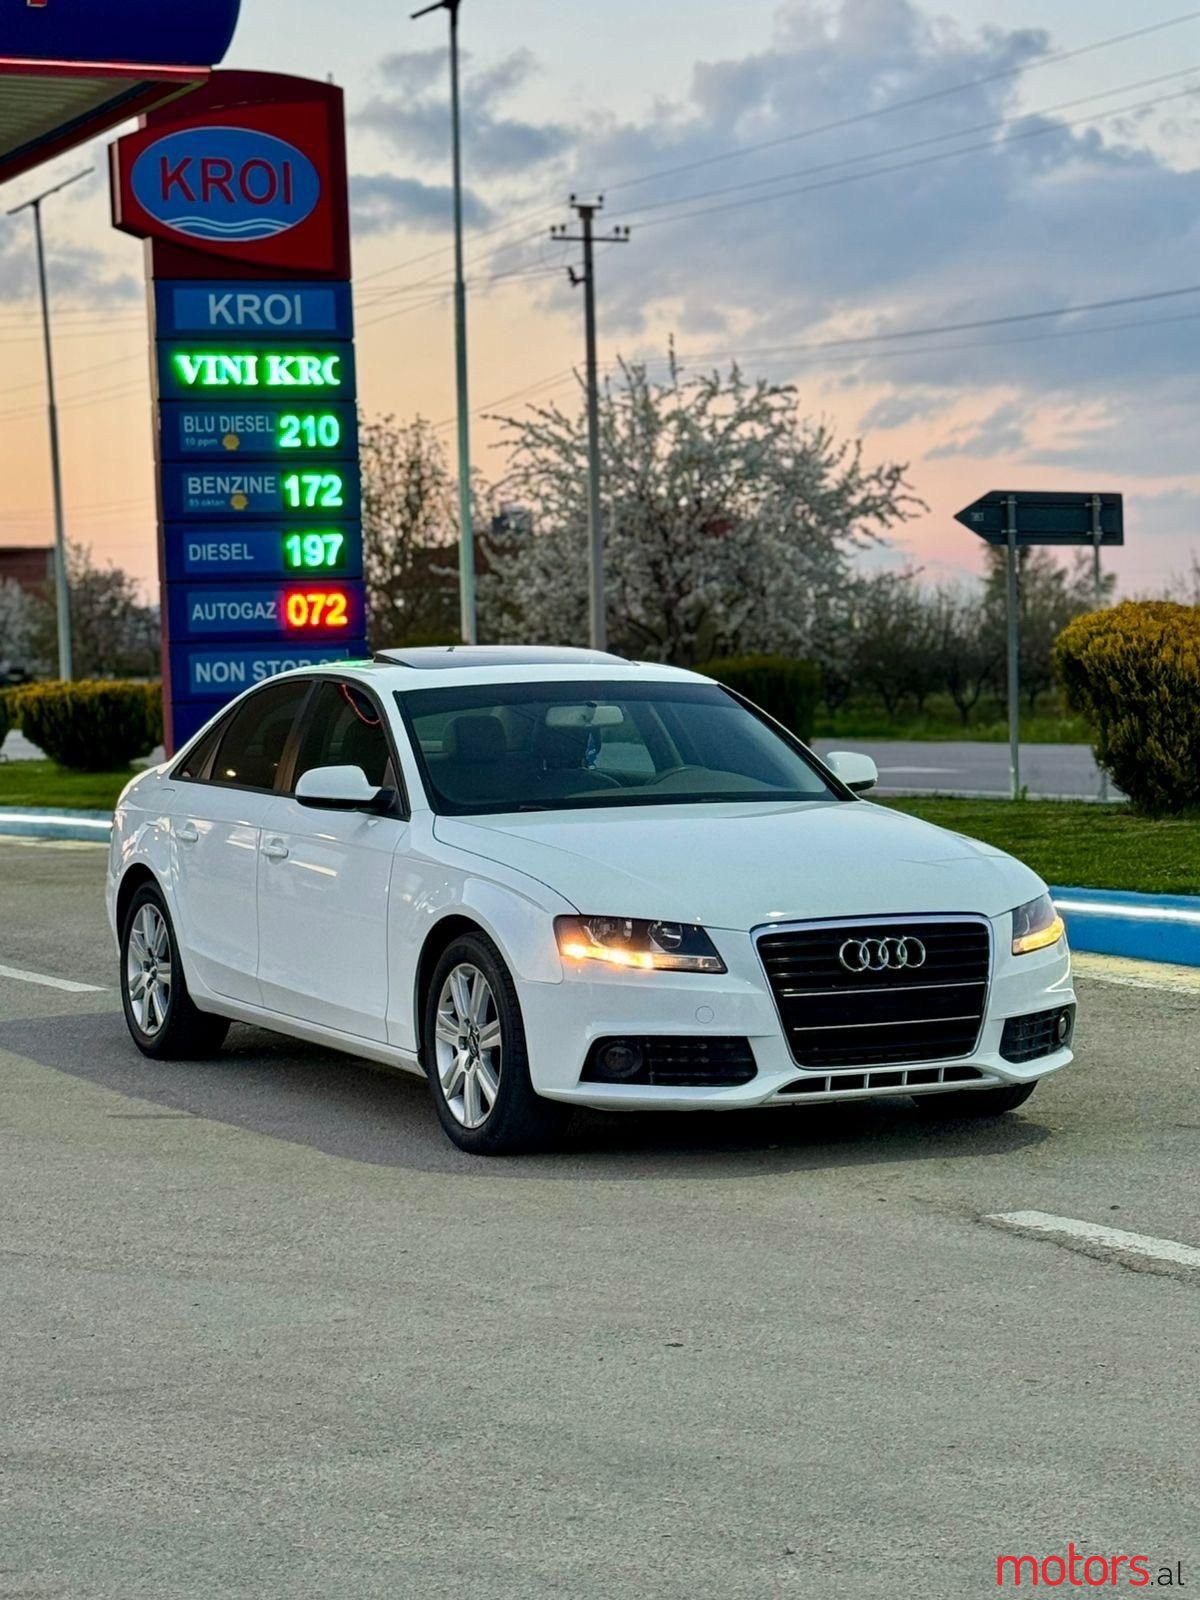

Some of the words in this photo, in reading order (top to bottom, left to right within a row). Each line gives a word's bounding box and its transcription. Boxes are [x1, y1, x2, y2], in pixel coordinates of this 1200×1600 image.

[160, 156, 293, 205] KROI
[208, 293, 302, 325] KROI
[175, 355, 259, 385] VINI
[183, 415, 215, 433] BLU
[219, 415, 275, 432] DIESEL
[279, 415, 340, 448] 210
[187, 476, 277, 494] BENZINE
[285, 475, 343, 507] 172
[188, 544, 254, 560] DIESEL
[286, 533, 344, 567] 197
[192, 602, 277, 620] AUTOGAZ
[287, 593, 348, 627] 072
[195, 661, 246, 683] NON
